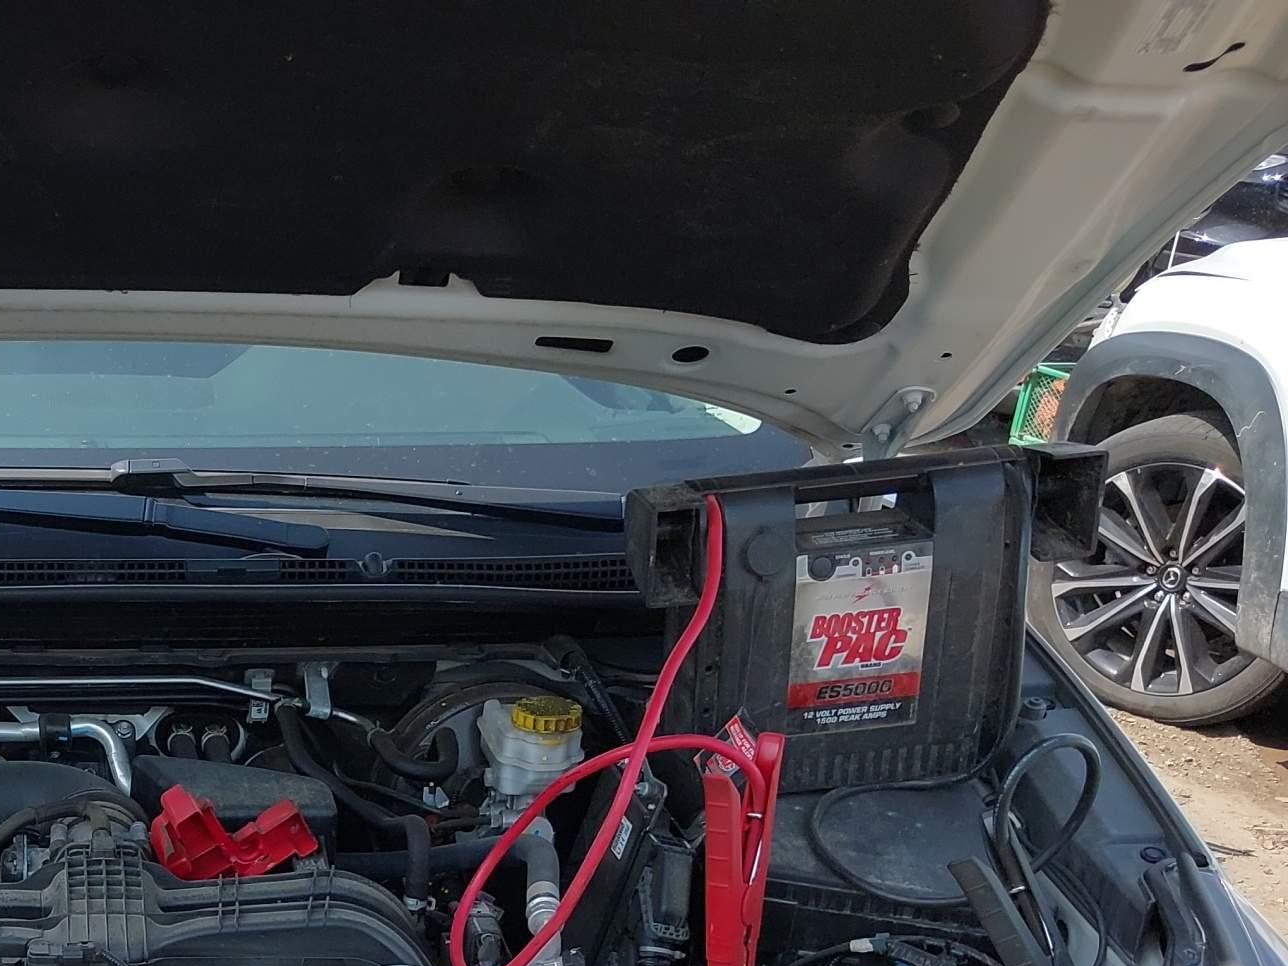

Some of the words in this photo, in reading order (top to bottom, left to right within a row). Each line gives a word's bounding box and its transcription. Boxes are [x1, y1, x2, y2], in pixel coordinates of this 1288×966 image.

[807, 606, 902, 641] BOOSTER
[814, 628, 908, 669] PAC
[817, 680, 892, 700] ES5000
[803, 711, 814, 719] 12
[815, 708, 838, 717] VOLT
[837, 705, 868, 716] POWER
[869, 702, 902, 712] SUPPLY
[815, 716, 838, 725] 1500
[838, 713, 861, 722] PEAK
[861, 710, 888, 720] AMPS
